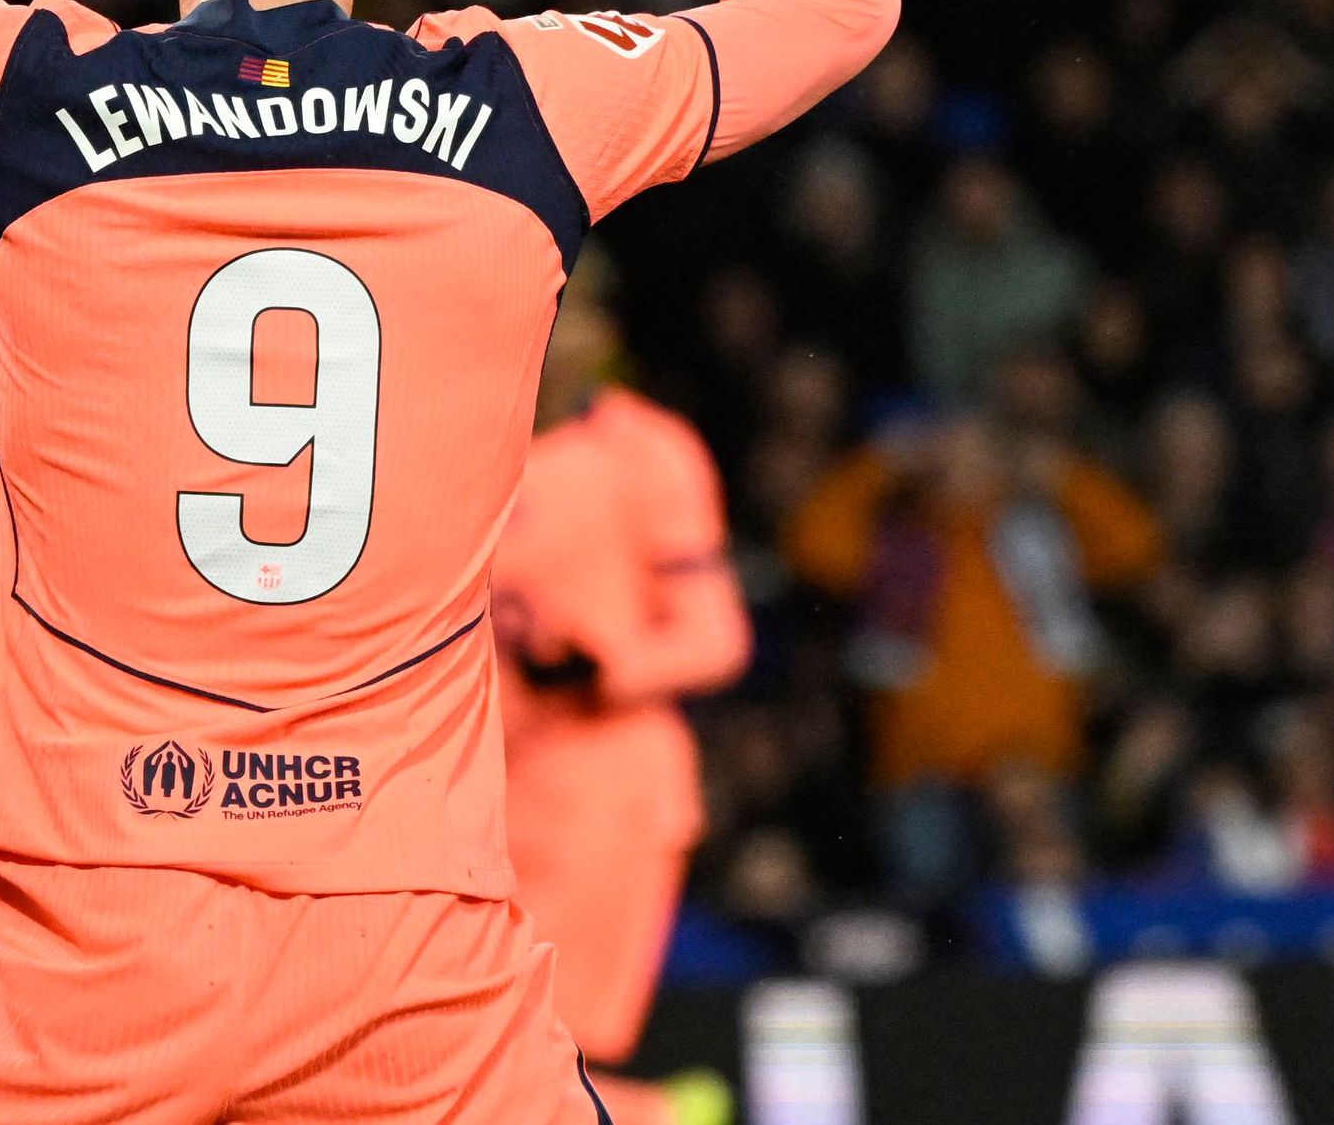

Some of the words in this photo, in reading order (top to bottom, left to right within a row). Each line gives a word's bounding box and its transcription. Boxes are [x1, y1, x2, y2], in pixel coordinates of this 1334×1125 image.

[55, 78, 493, 173] LEWANDOWSKI
[175, 247, 382, 605] 9
[222, 750, 361, 780] UNHCR
[220, 779, 362, 809] ACNUR
[222, 810, 244, 820] The
[247, 810, 265, 820] UN
[268, 806, 316, 820] Refugee
[319, 801, 363, 813] Agency
